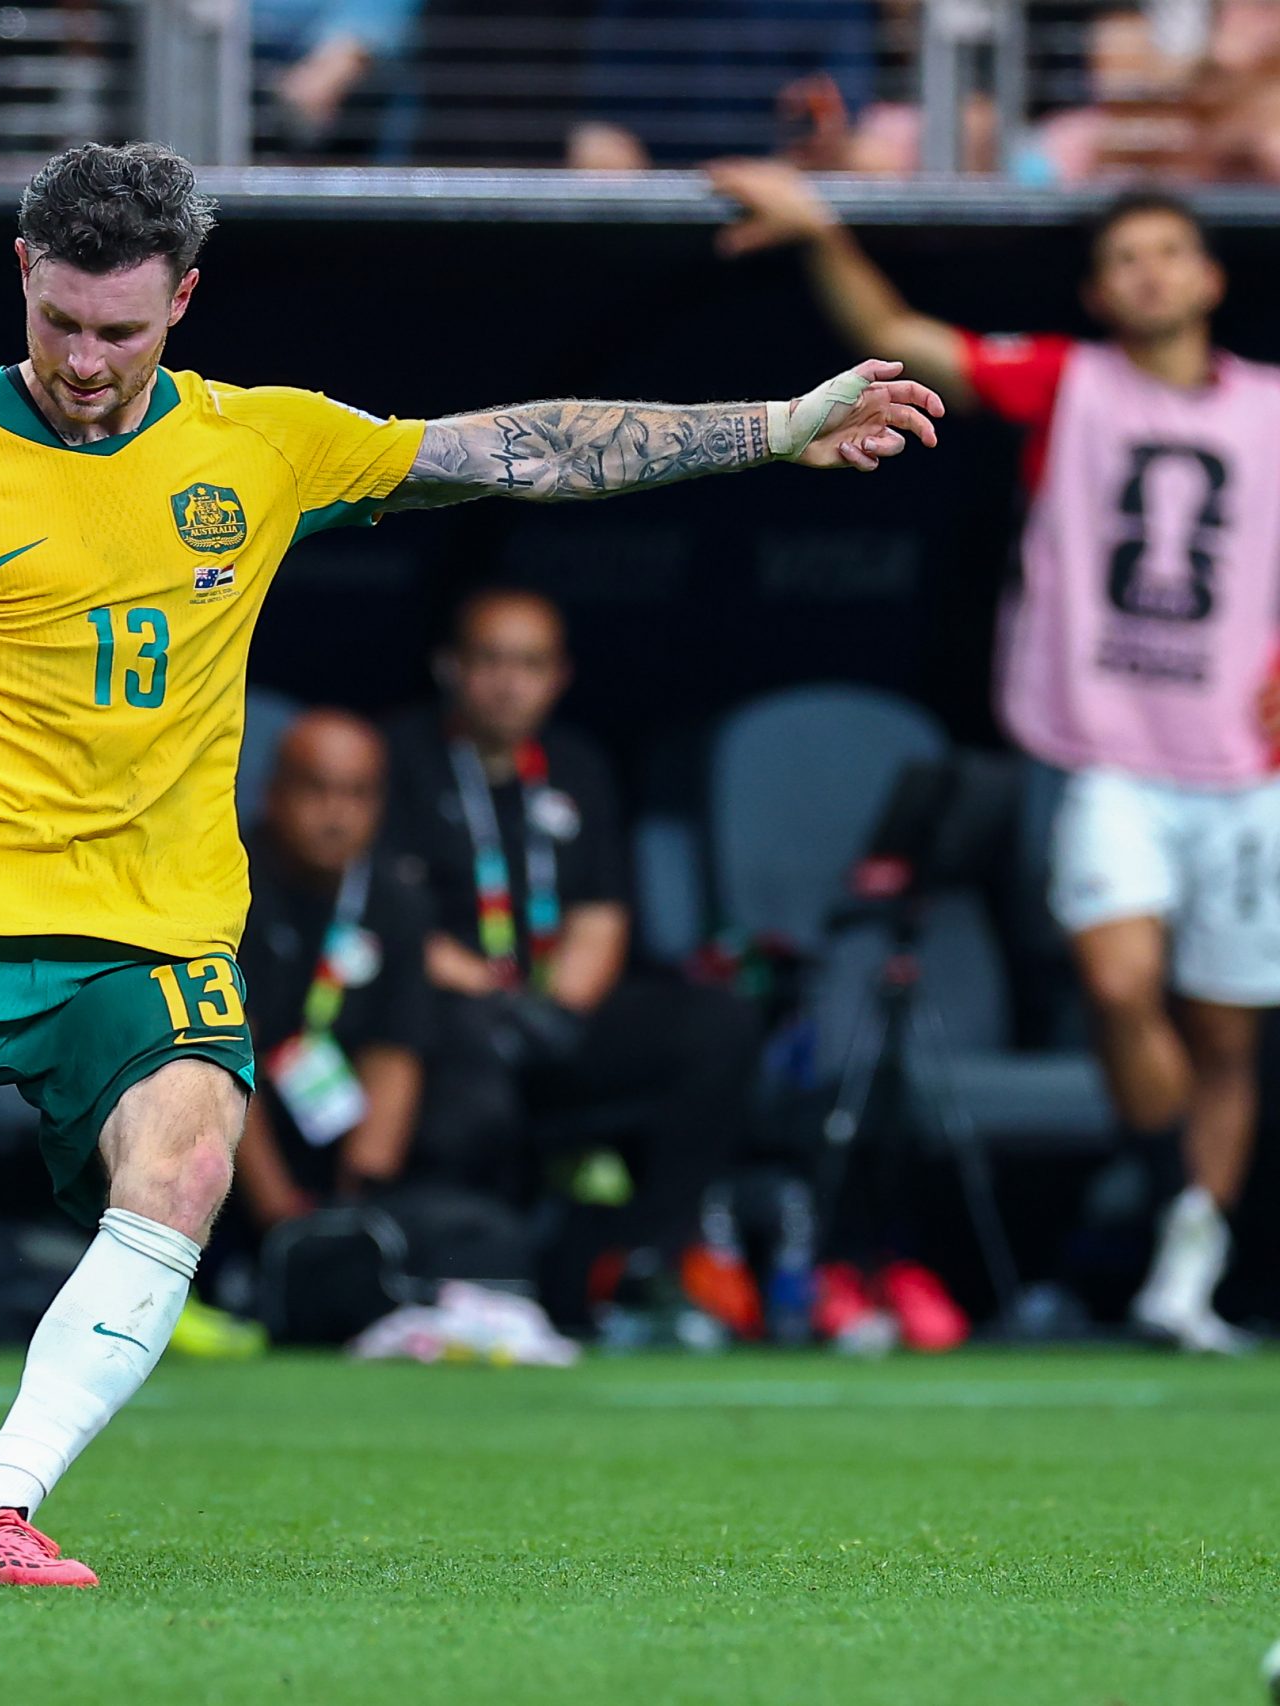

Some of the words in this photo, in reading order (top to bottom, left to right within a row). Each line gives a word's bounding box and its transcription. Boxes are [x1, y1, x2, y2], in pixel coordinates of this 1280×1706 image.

[190, 525, 238, 537] AUSTRALIA
[87, 607, 170, 709] 13
[149, 957, 245, 1031] 13
